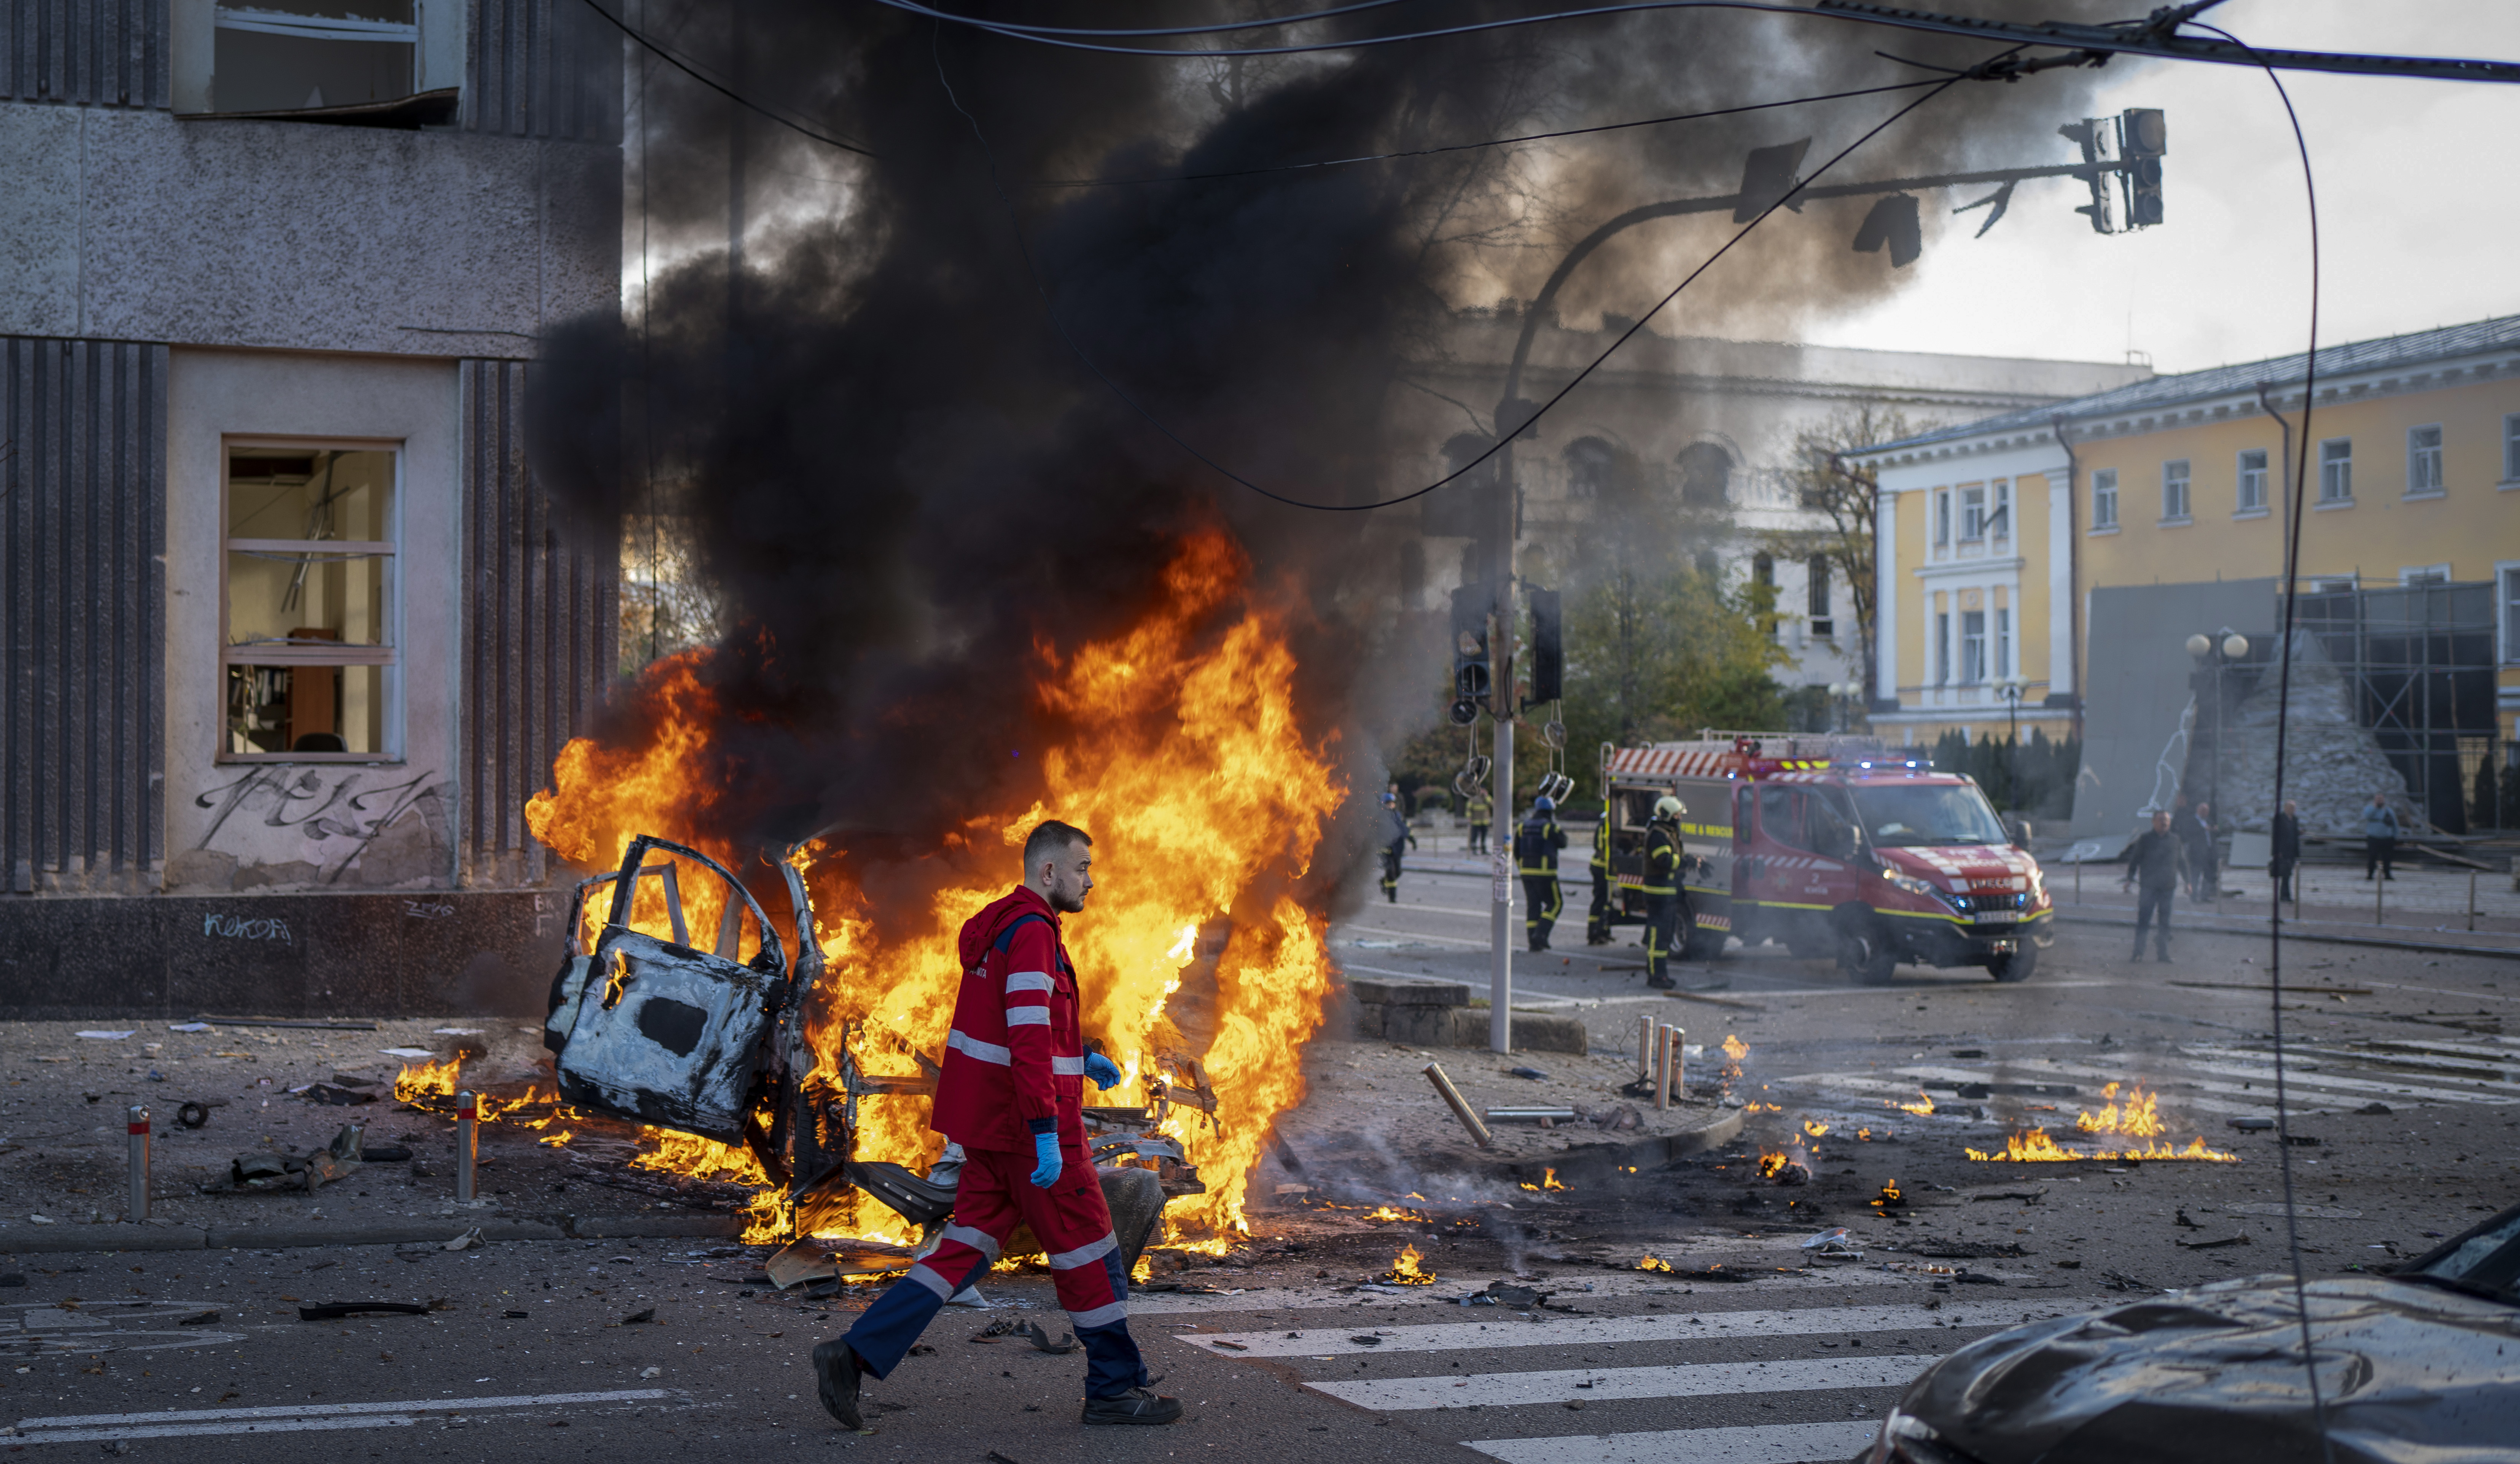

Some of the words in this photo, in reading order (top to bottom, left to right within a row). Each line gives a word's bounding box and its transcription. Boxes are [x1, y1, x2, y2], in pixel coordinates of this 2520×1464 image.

[1680, 822, 1697, 835] FIRE
[1698, 823, 1704, 836] &
[1705, 824, 1734, 839] RESCUE
[1812, 872, 1820, 885] 2
[1971, 877, 2013, 890] IVECO
